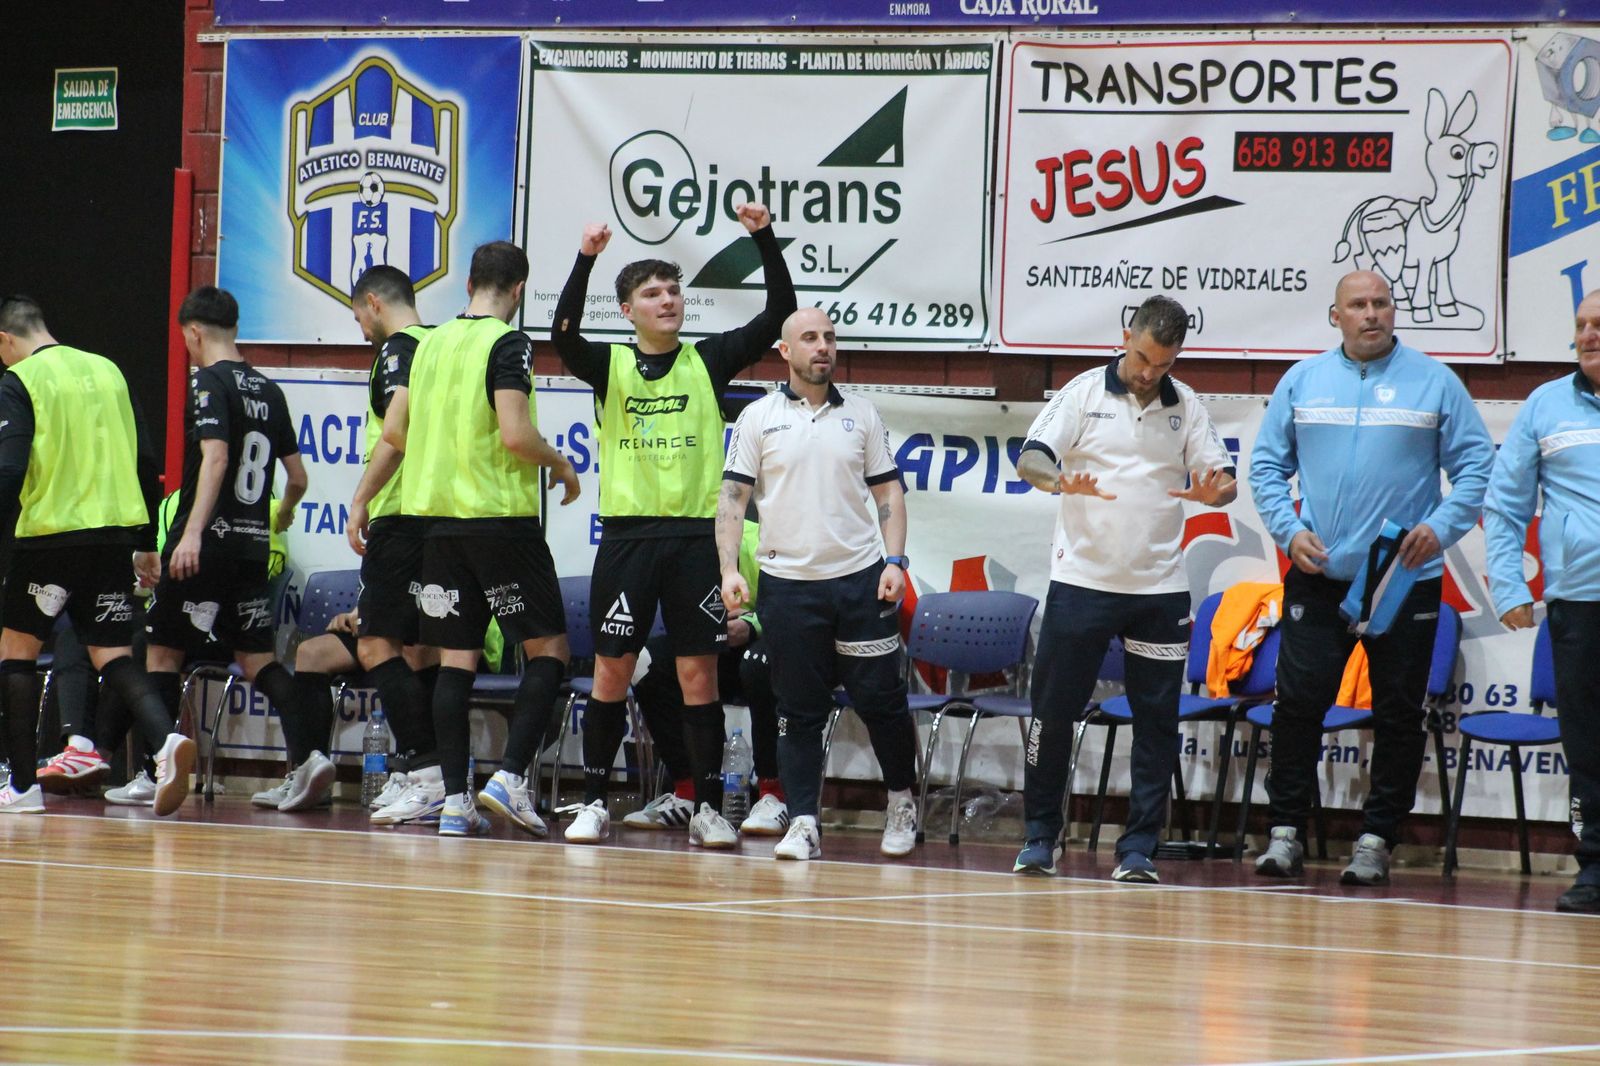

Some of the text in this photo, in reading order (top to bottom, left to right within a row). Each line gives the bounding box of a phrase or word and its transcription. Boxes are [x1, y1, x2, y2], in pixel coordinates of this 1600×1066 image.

[889, 3, 931, 16] ENAMORA
[539, 49, 628, 69] EXCAVACIONES
[640, 51, 716, 70] MOVIMIENTO
[718, 51, 734, 70] DE
[736, 51, 787, 71] TIERRAS
[799, 51, 845, 71] PLANTA
[847, 52, 863, 71] DE
[864, 49, 933, 71] HORMIGÓN
[932, 51, 942, 71] Y
[944, 49, 990, 70] ÁRIDOS
[63, 79, 109, 98] SALIDA DE
[1030, 56, 1399, 105] TRANSPORTES
[57, 100, 115, 120] EMERGENCIA
[358, 112, 389, 127] CLUB
[1237, 137, 1390, 168] 658 913 682
[299, 152, 446, 183] ATLETICO BENAVENTE
[1030, 136, 1207, 224] JESUS
[622, 157, 902, 236] Gejotrans
[800, 243, 849, 274] S.L.
[1026, 259, 1308, 293] SANTIBAÑEZ DE VIDRIALES
[814, 301, 974, 328] 66 416 289
[619, 435, 697, 450] RENACE
[233, 431, 272, 505] 8
[497, 601, 525, 617] .com
[1485, 684, 1518, 707] 63
